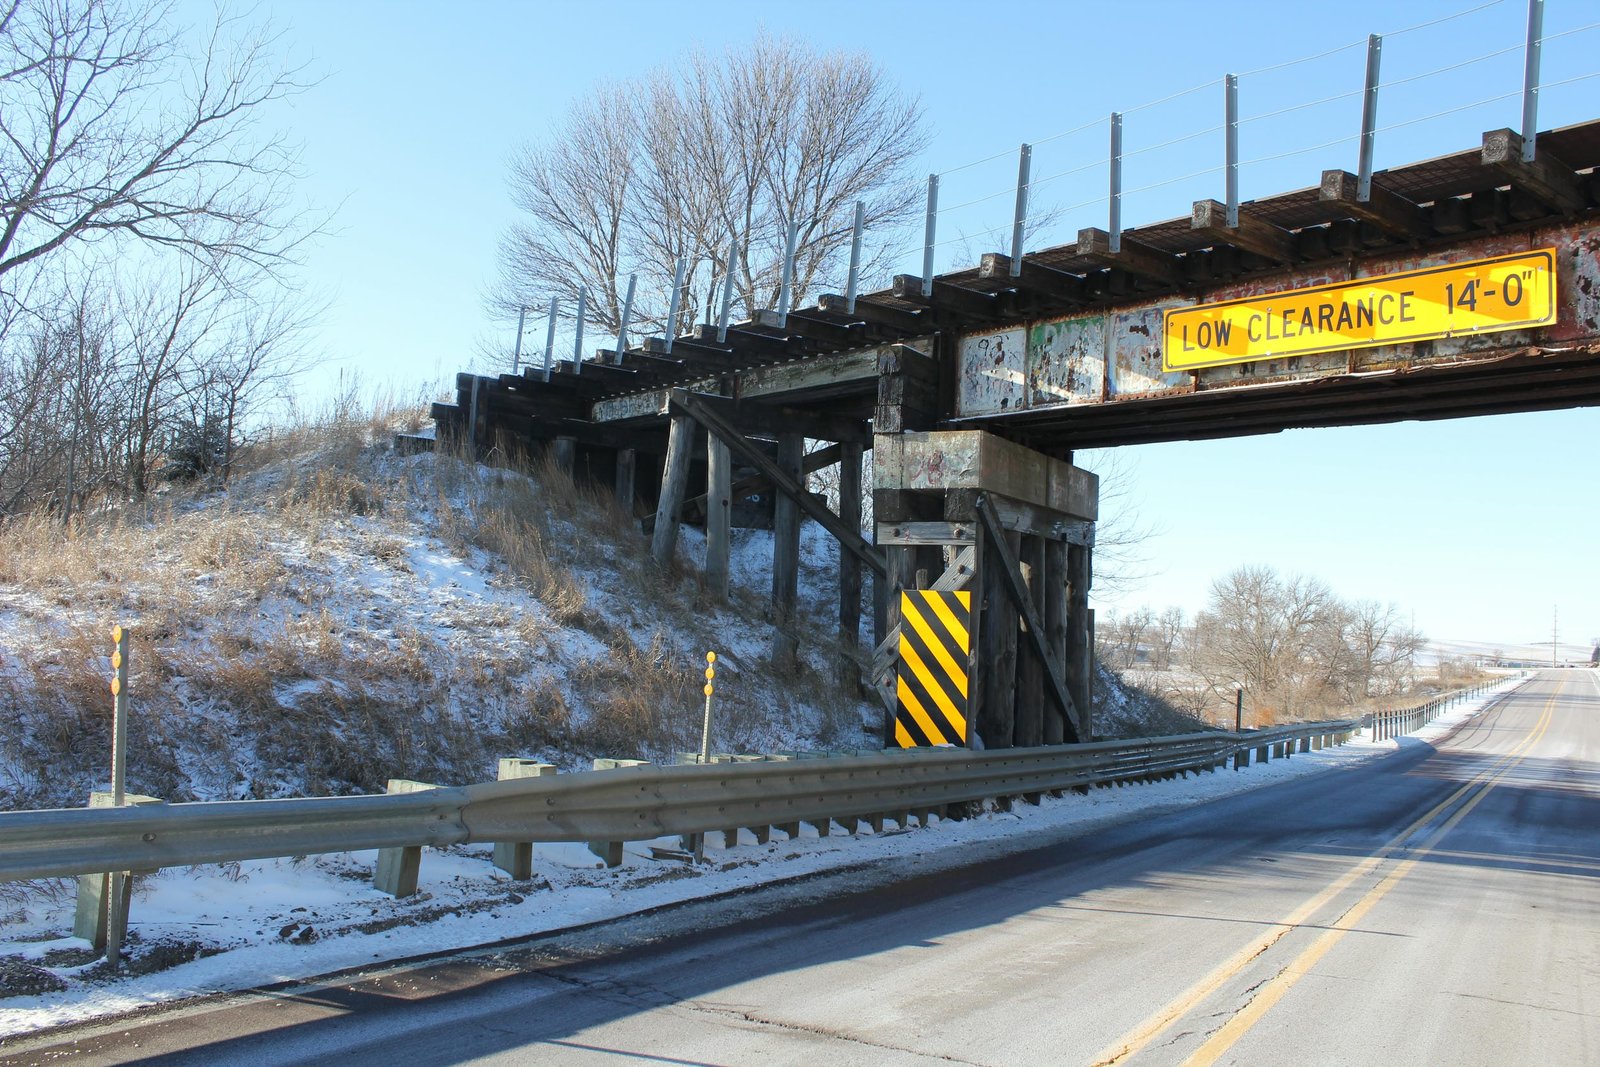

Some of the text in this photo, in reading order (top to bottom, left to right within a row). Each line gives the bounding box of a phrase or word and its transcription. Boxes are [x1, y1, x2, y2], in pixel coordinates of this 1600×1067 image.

[1182, 270, 1533, 352] LOW CLEARANCE 14'-0"
